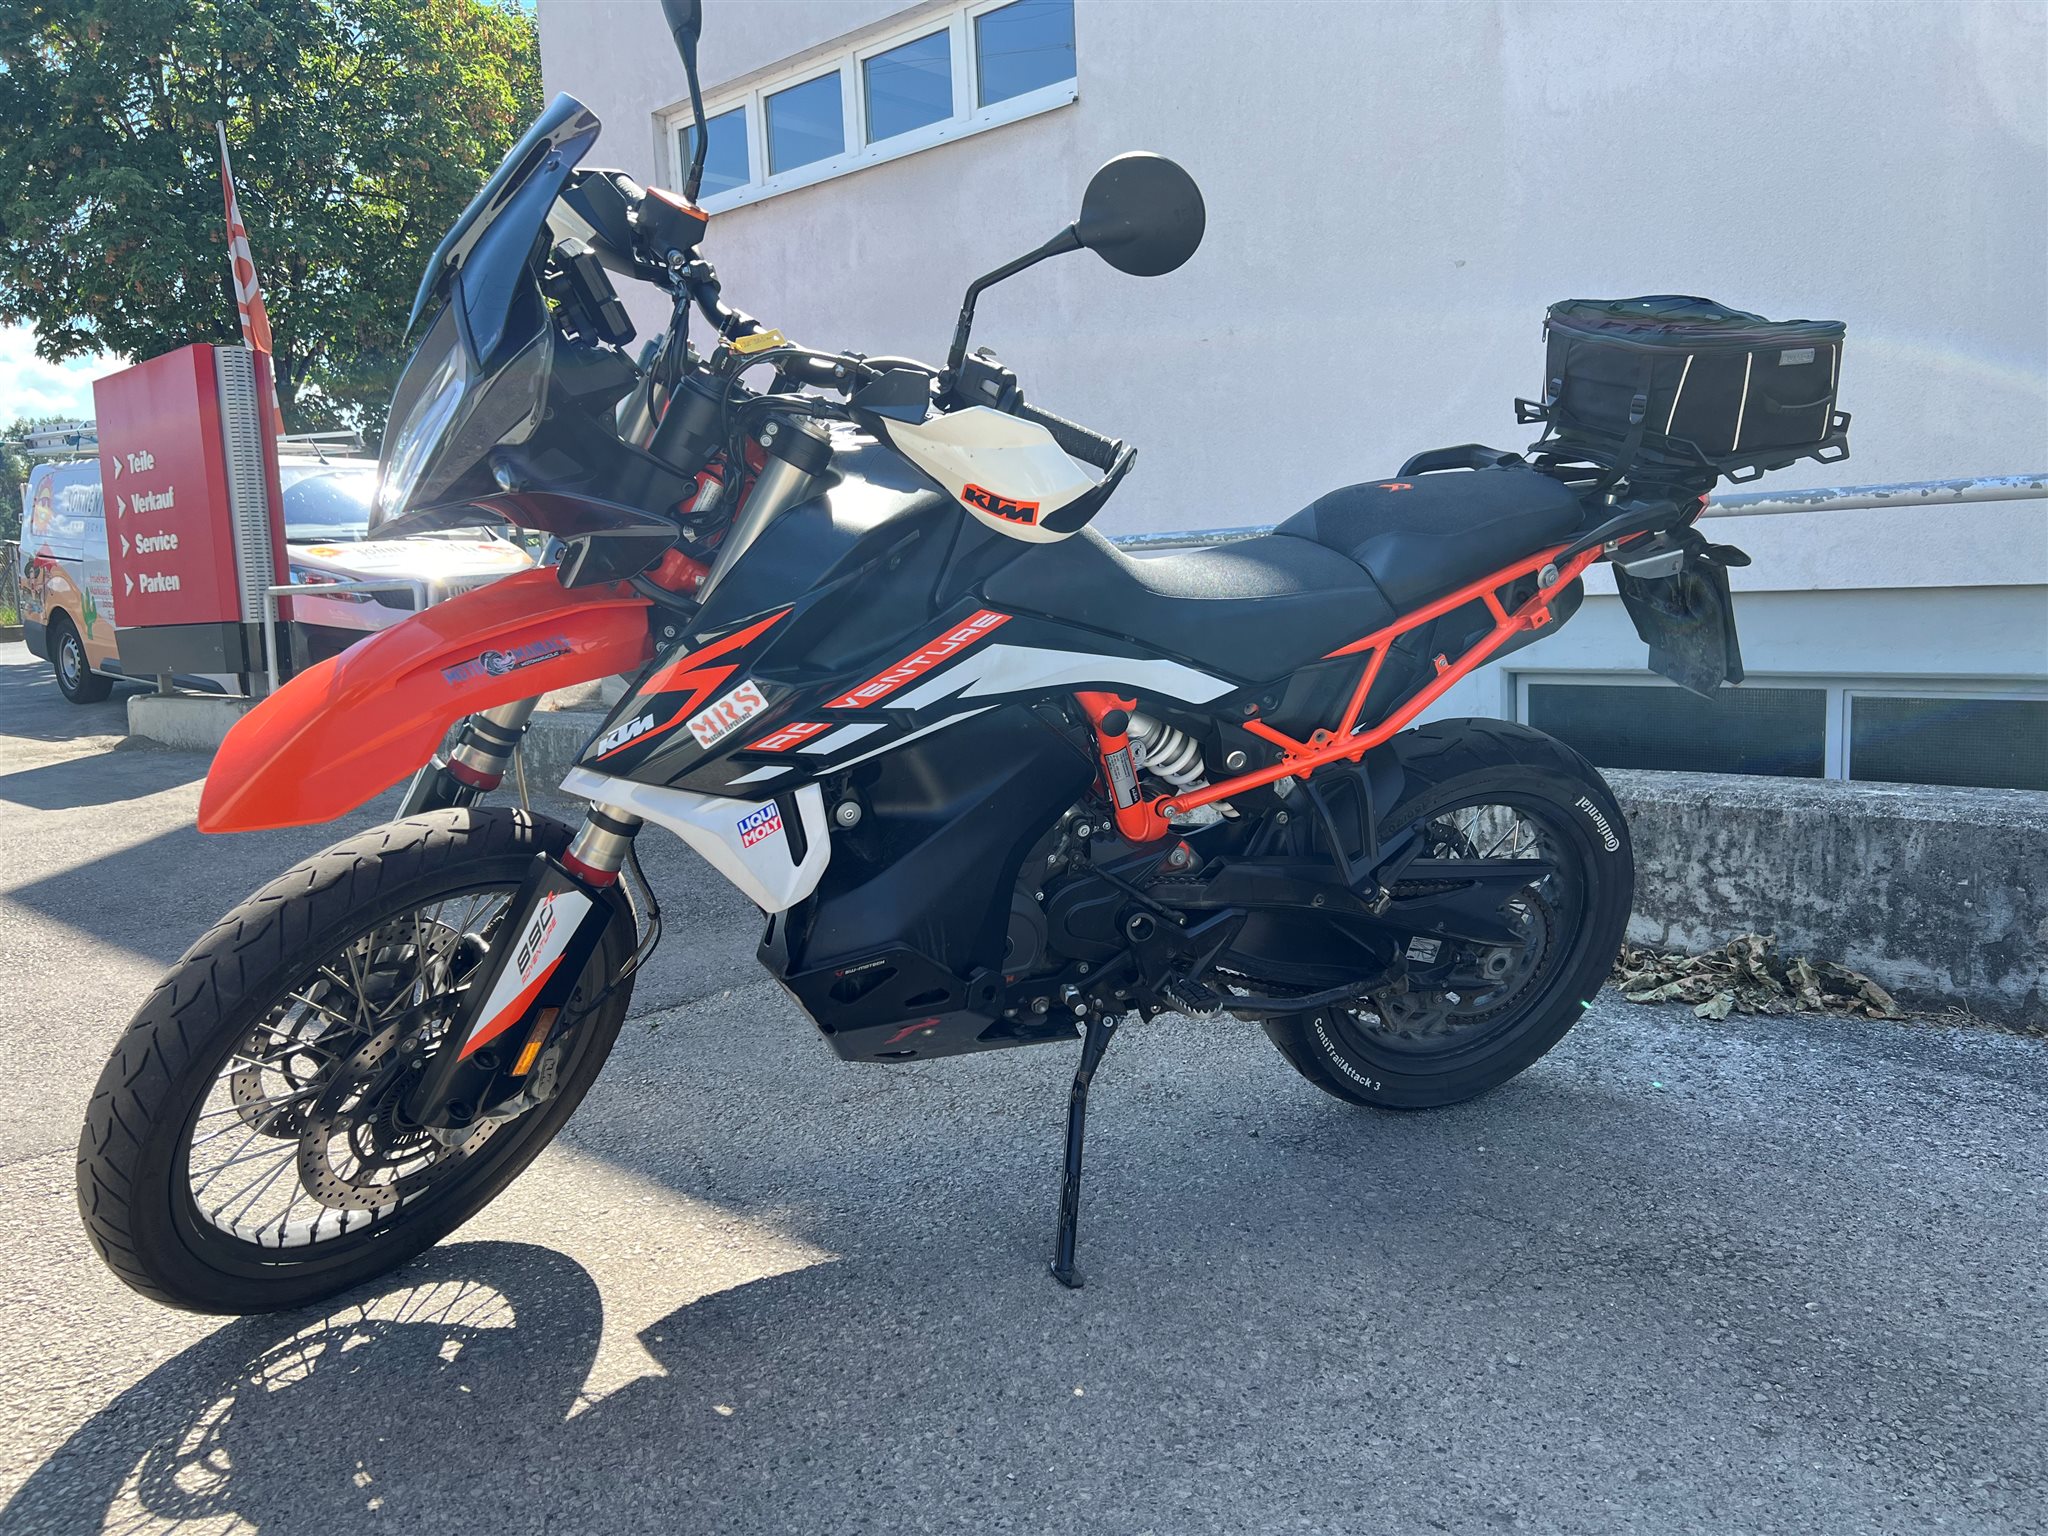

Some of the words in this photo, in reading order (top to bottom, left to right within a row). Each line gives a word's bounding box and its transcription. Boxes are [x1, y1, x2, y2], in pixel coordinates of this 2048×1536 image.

[127, 450, 155, 474] Teile
[131, 486, 175, 514] Verkauf
[964, 487, 1035, 523] KTM
[135, 530, 179, 555] Service
[139, 572, 181, 594] Parken
[690, 685, 762, 745] MRS
[724, 712, 753, 732] EXPERIENCE
[597, 713, 655, 757] KTM
[738, 803, 777, 834] LIQUI
[743, 816, 780, 847] MOLY
[1574, 795, 1620, 852] Continental
[517, 903, 553, 976] 890
[521, 916, 557, 984] ADVENTURE
[844, 959, 886, 976] SW-MOTECH
[1314, 1017, 1372, 1088] ContiTrailAttack
[1373, 1081, 1381, 1091] 3
